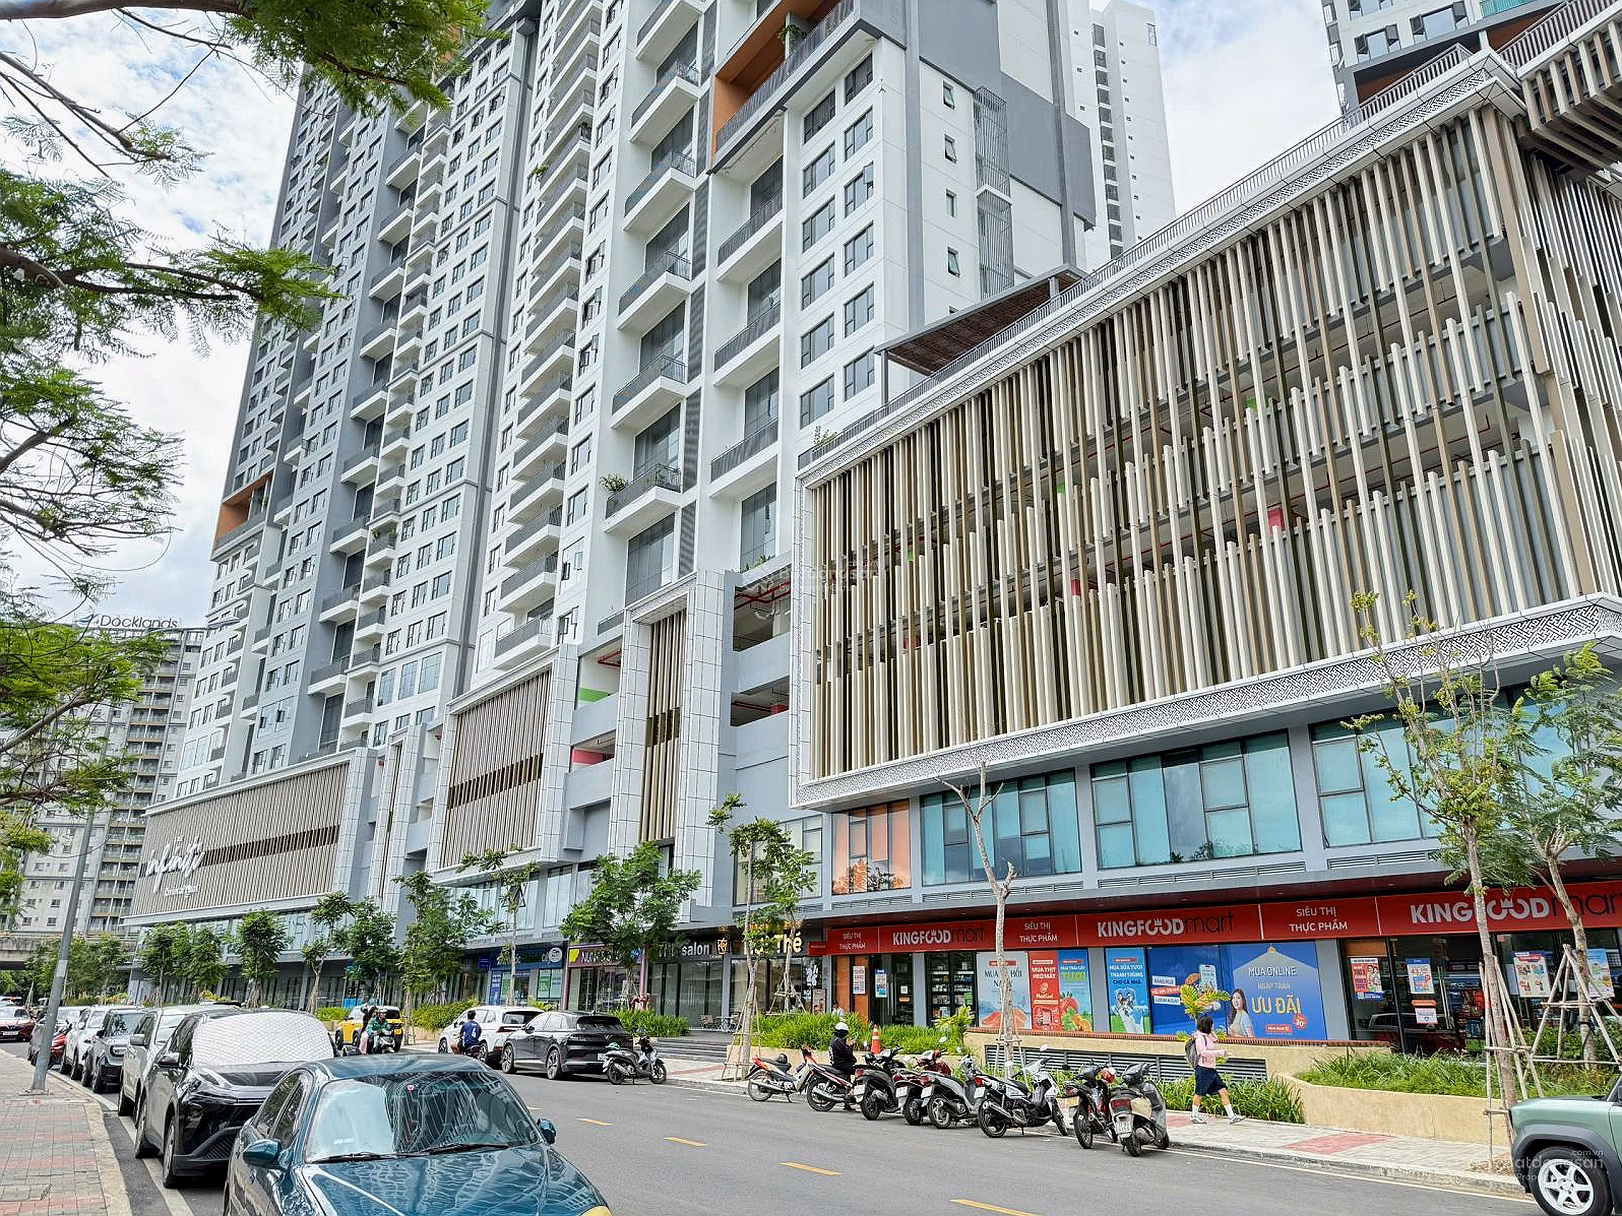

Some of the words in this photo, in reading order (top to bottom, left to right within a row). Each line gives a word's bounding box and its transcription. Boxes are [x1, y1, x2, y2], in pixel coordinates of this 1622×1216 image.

[100, 614, 178, 629] Docklands
[1295, 906, 1317, 918] SIÊU
[1289, 920, 1316, 934] THỰC
[1317, 918, 1348, 931] PHẨM
[681, 941, 710, 957] salon
[1248, 966, 1265, 977] MUA
[1266, 965, 1298, 977] ONLINE
[1251, 995, 1272, 1014] ƯU
[1275, 994, 1302, 1014] ĐÃI
